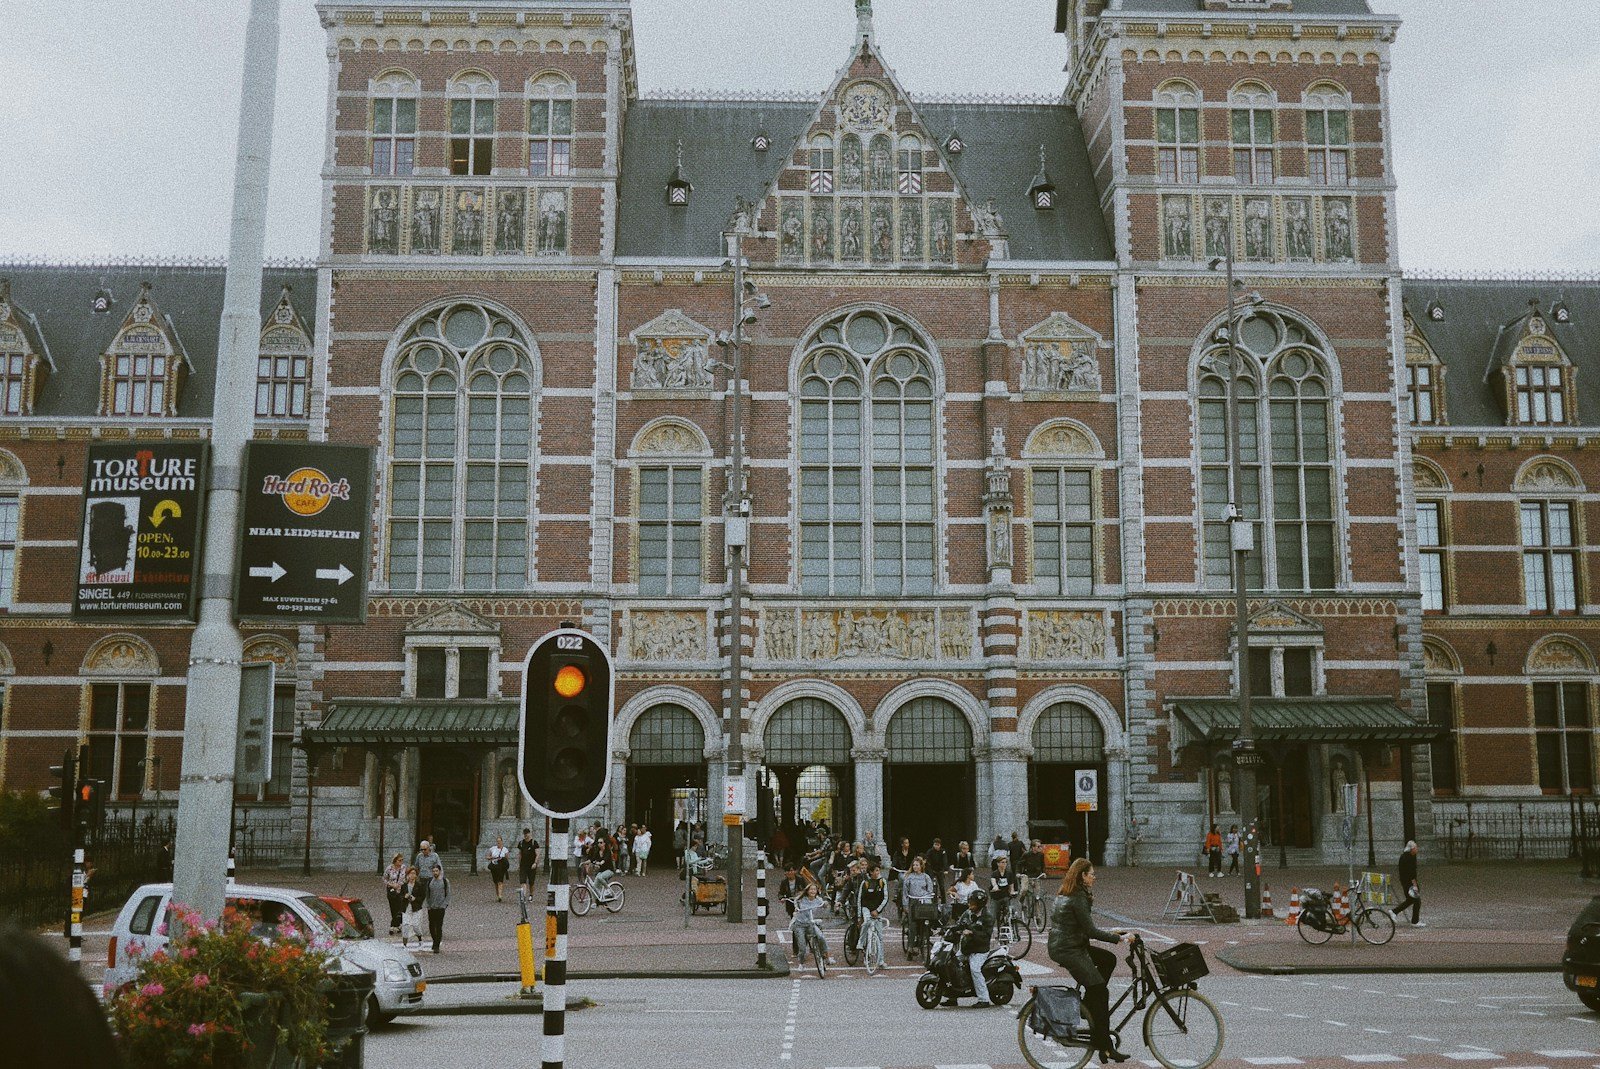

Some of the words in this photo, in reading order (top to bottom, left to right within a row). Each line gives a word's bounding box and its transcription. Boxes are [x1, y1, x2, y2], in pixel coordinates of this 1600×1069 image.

[92, 450, 196, 477] TORTURE
[90, 476, 195, 491] museum
[262, 475, 306, 494] Hard
[308, 478, 350, 500] Rock
[295, 499, 317, 507] CAFE
[138, 533, 174, 543] OPEN:
[249, 528, 281, 536] NEAR
[284, 528, 360, 539] LEIDSEPLEIN
[79, 588, 115, 600] SINGEL
[116, 591, 131, 599] 449
[80, 601, 183, 610] www.torturemuseum.com
[557, 636, 583, 650] 022
